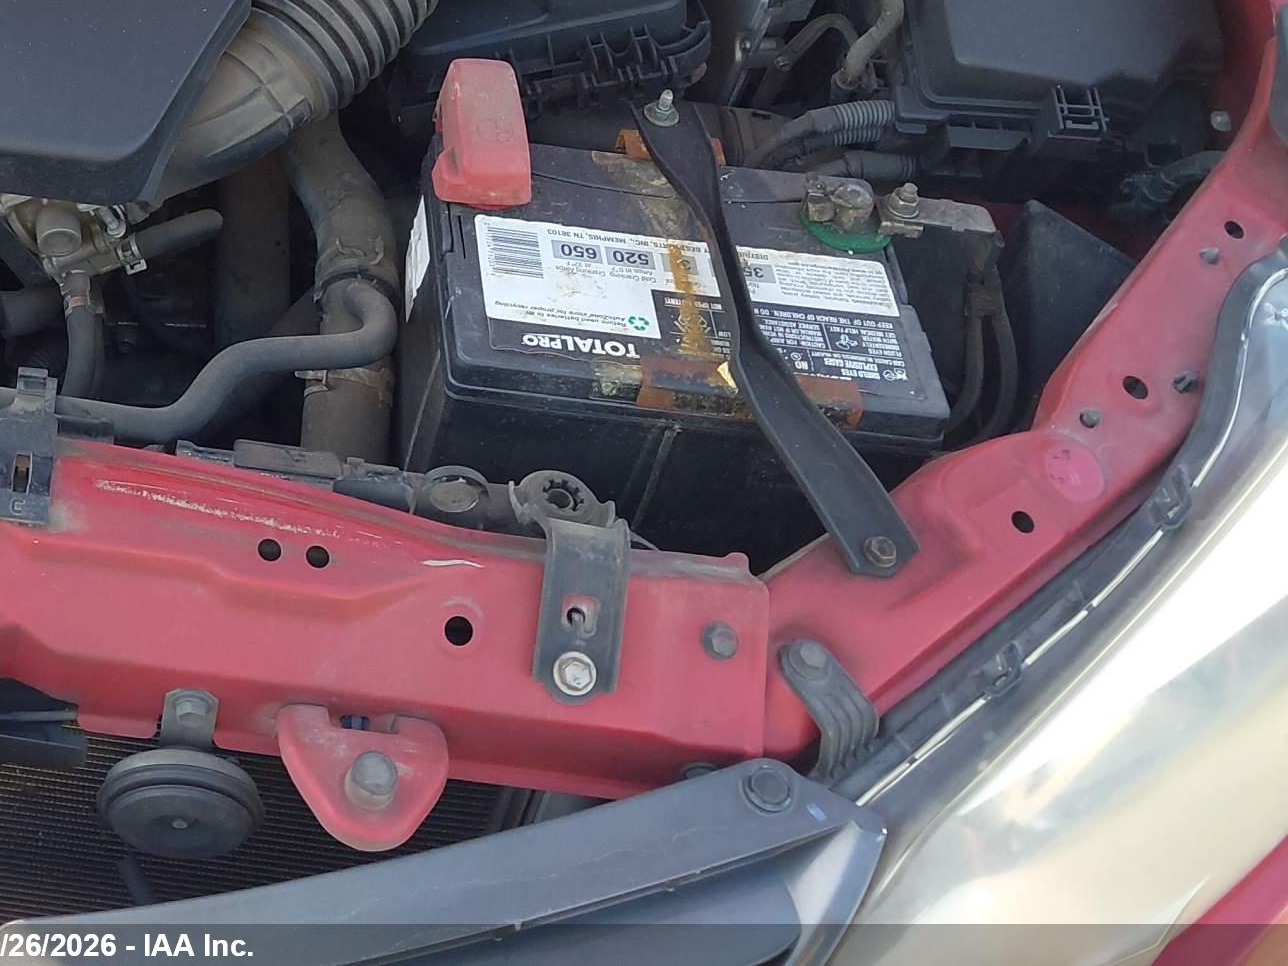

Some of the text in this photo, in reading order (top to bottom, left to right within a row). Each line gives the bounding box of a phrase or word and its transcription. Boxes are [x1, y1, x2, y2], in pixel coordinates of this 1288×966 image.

[560, 243, 598, 260] 650
[612, 250, 650, 266] 520
[838, 317, 852, 325] THE
[863, 320, 877, 328] OUT
[877, 321, 894, 329] KEEP
[521, 333, 641, 359] TOTALPRO
[794, 360, 809, 370] NO
